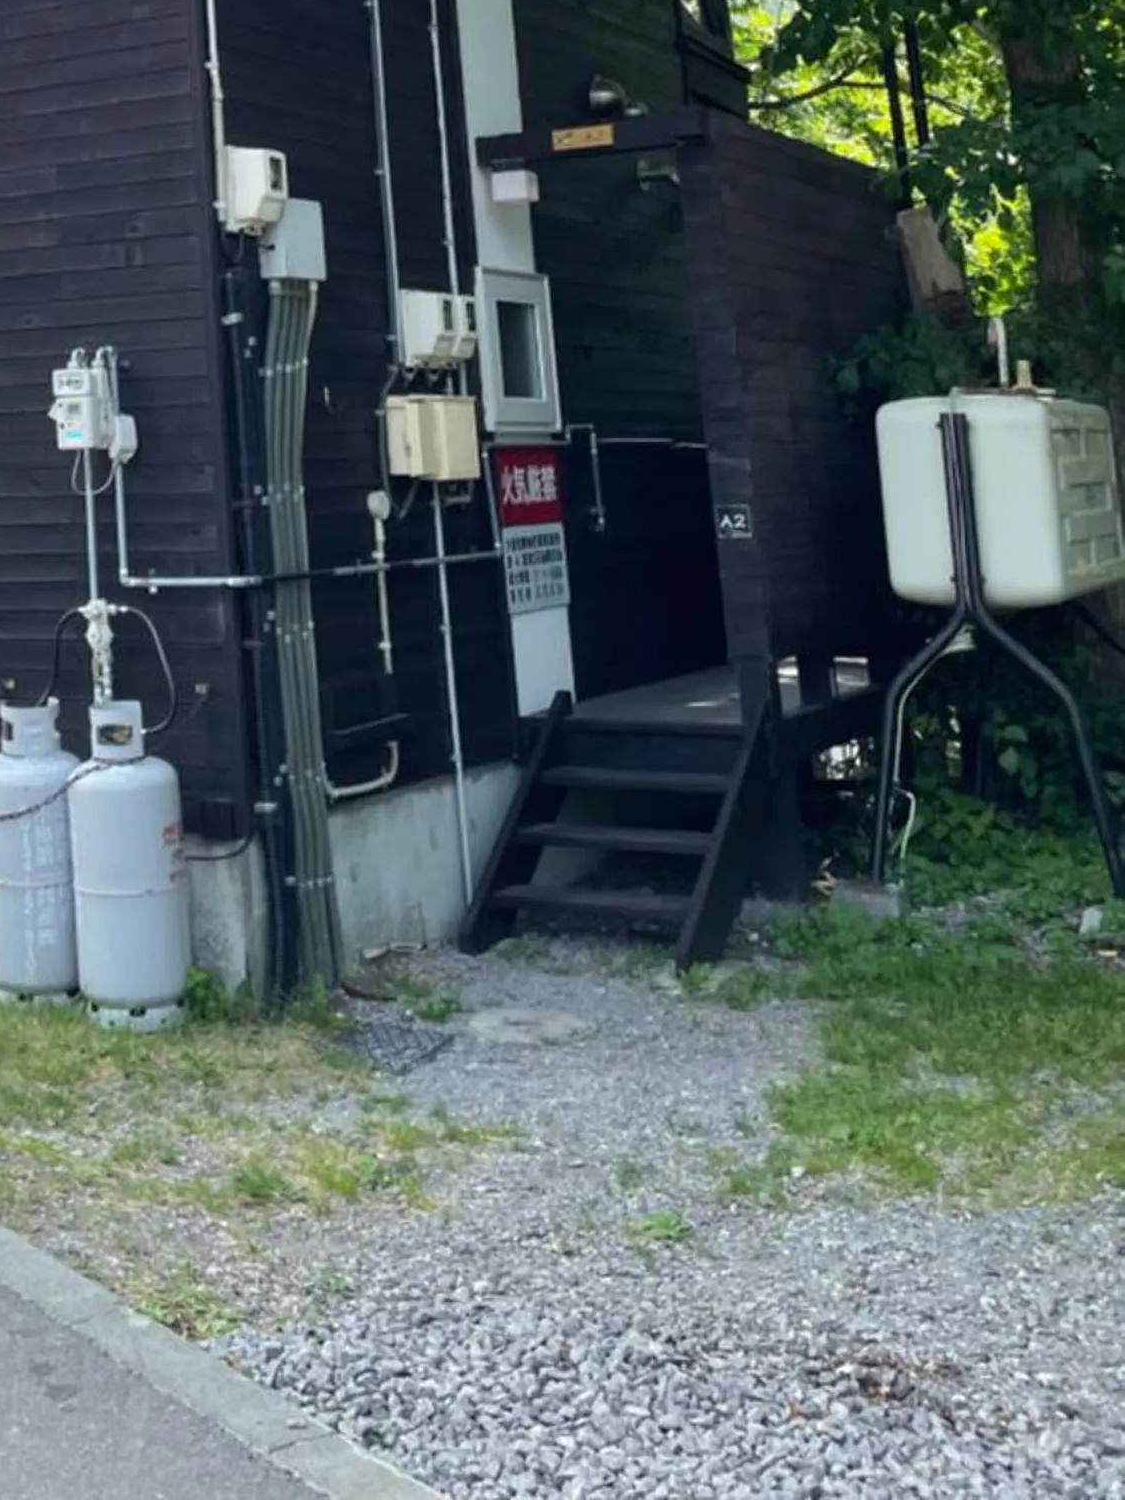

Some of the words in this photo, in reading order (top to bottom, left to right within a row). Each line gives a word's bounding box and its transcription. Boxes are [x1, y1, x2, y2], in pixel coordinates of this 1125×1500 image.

[501, 464, 557, 504] 火気厳禁
[719, 513, 746, 528] A2
